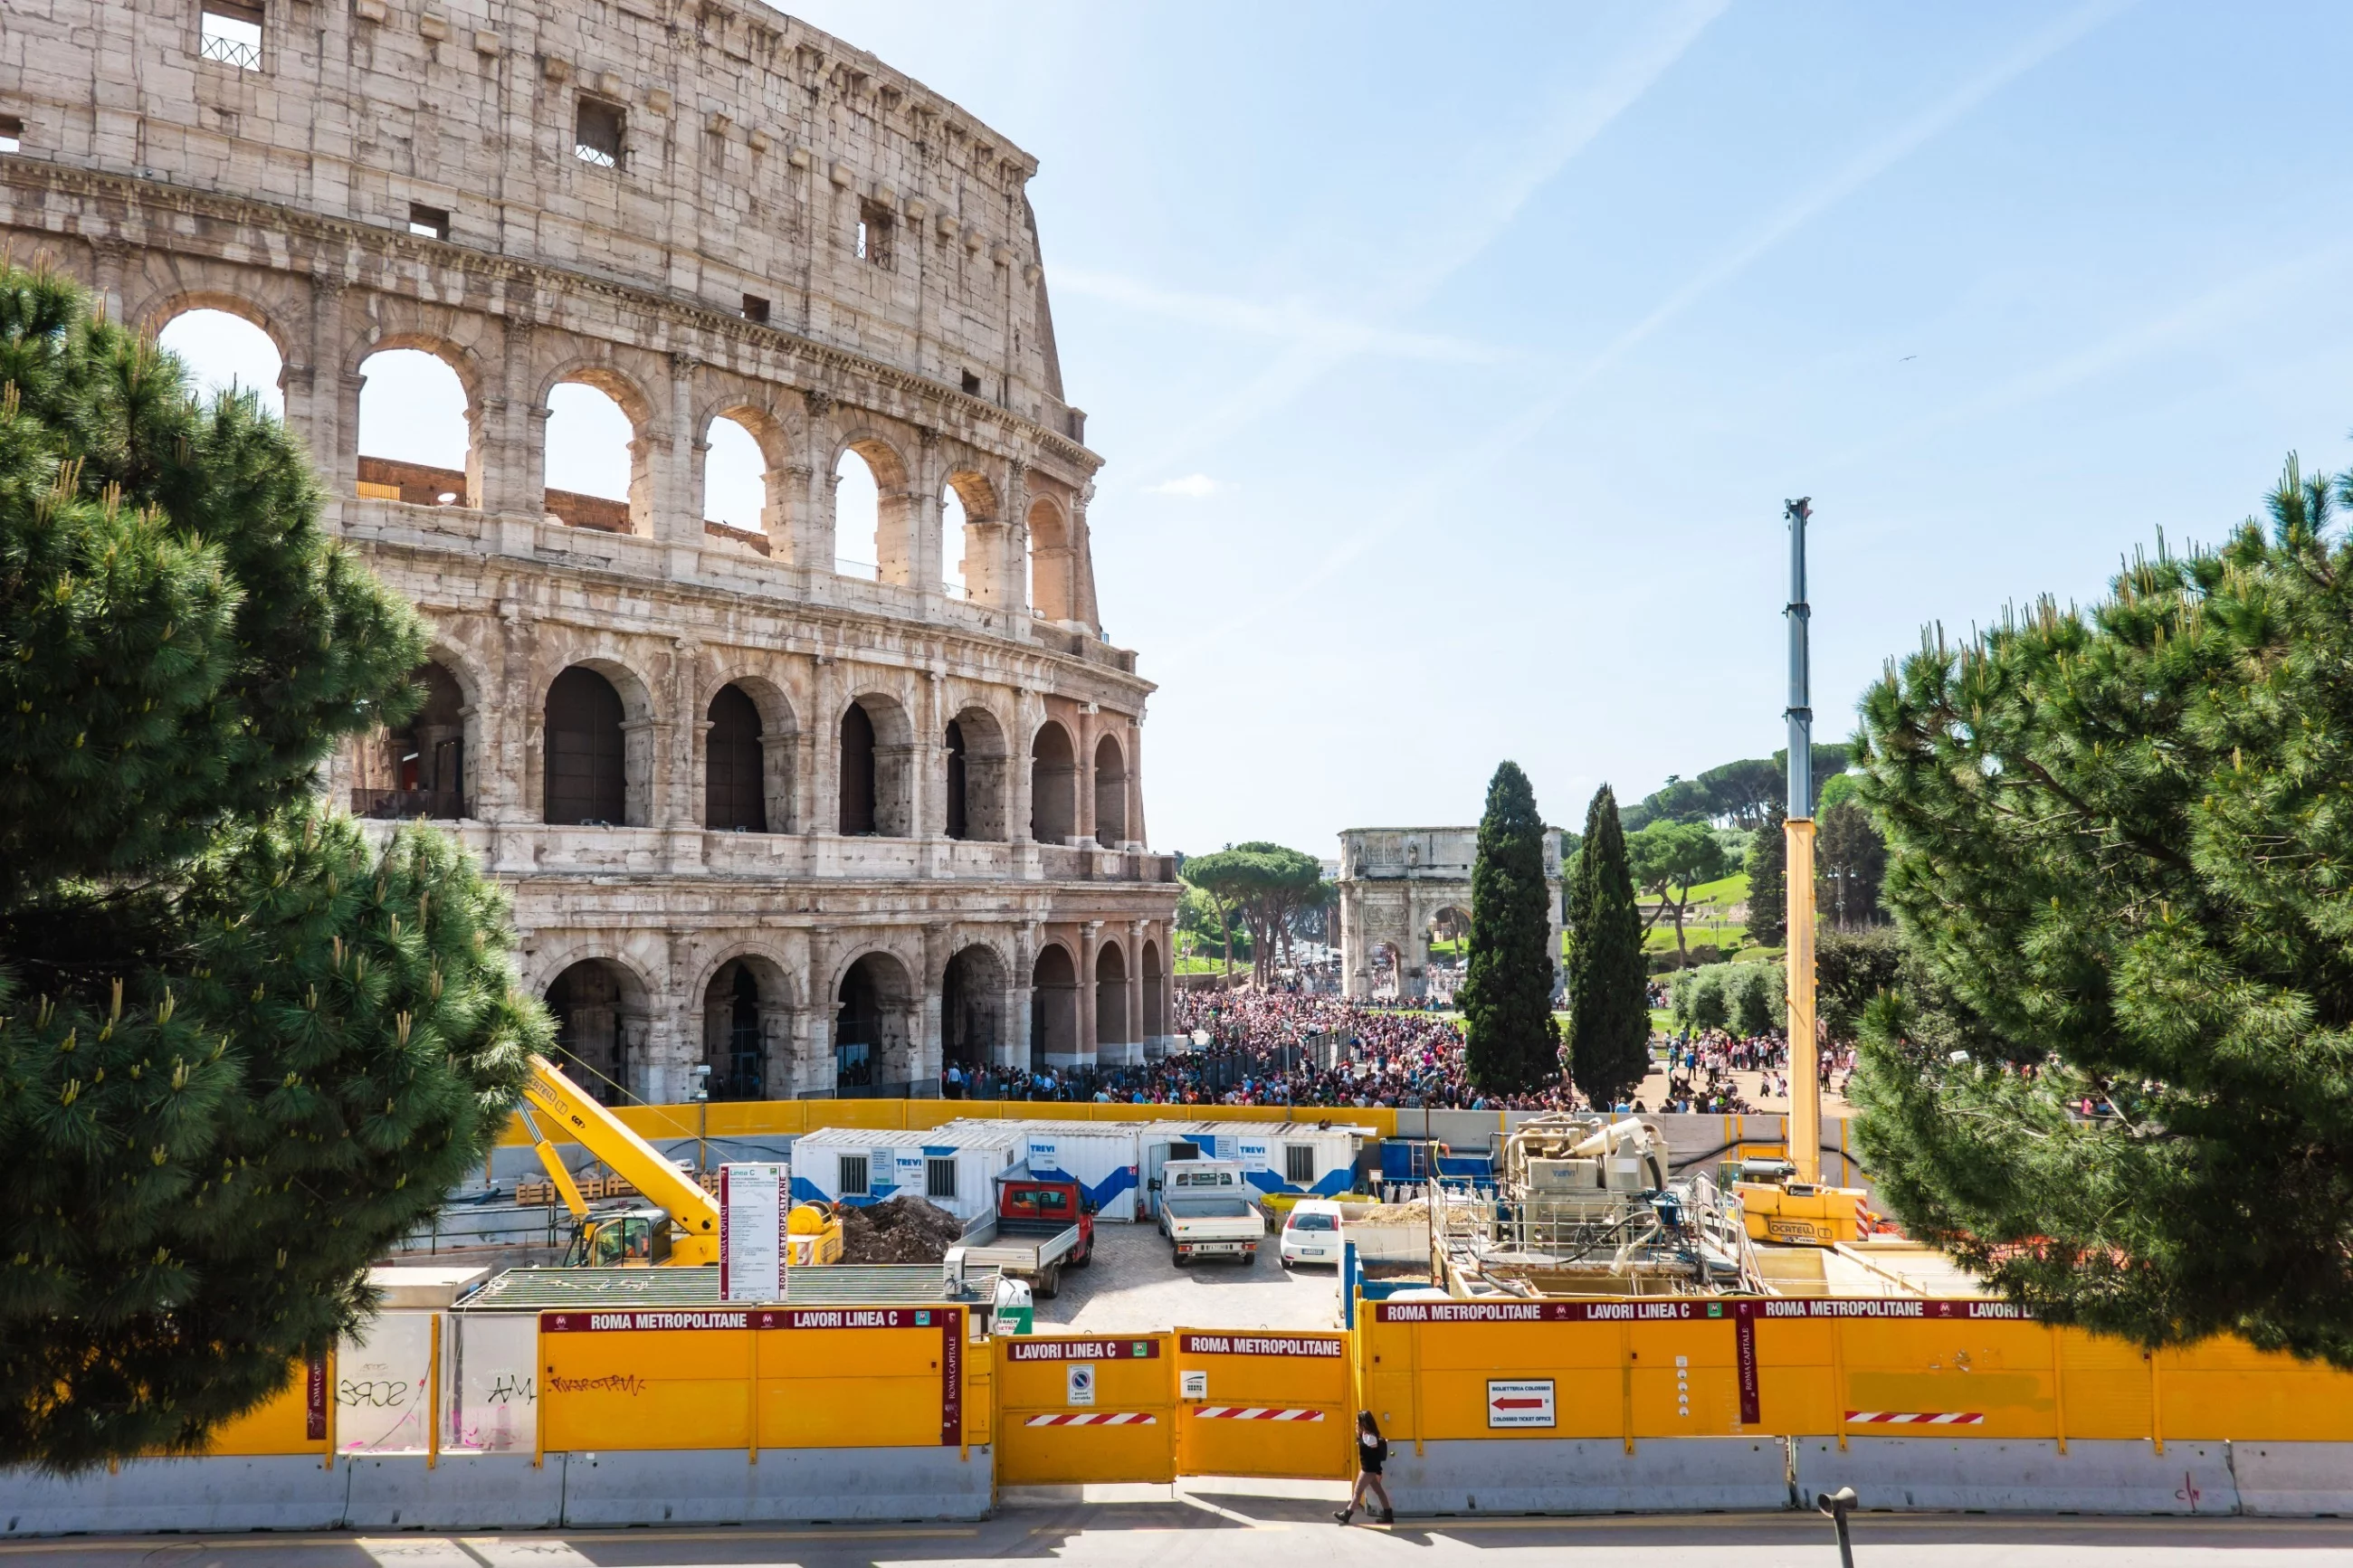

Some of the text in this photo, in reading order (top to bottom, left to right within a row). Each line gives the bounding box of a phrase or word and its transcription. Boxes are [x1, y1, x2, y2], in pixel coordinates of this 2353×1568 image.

[1030, 1145, 1055, 1153] TREVI
[1240, 1145, 1265, 1154] TREVI
[896, 1158, 922, 1166] TREVI
[1387, 1304, 1541, 1320] ROMA METROPOLITANE
[1586, 1303, 1691, 1319] LAVORI LINEA C
[1766, 1301, 1924, 1316] ROMA METROPOLITANE
[1969, 1302, 2019, 1318] LAVORI
[592, 1314, 748, 1329] ROMA METROPOLITANE
[795, 1311, 898, 1327] LAVORI LINEA C
[1015, 1342, 1116, 1359] LAVORI LINEA C
[1191, 1336, 1340, 1355] ROMA METROPOLITANE
[1742, 1327, 1751, 1365] CAPITALE
[313, 1383, 321, 1407] ROMA
